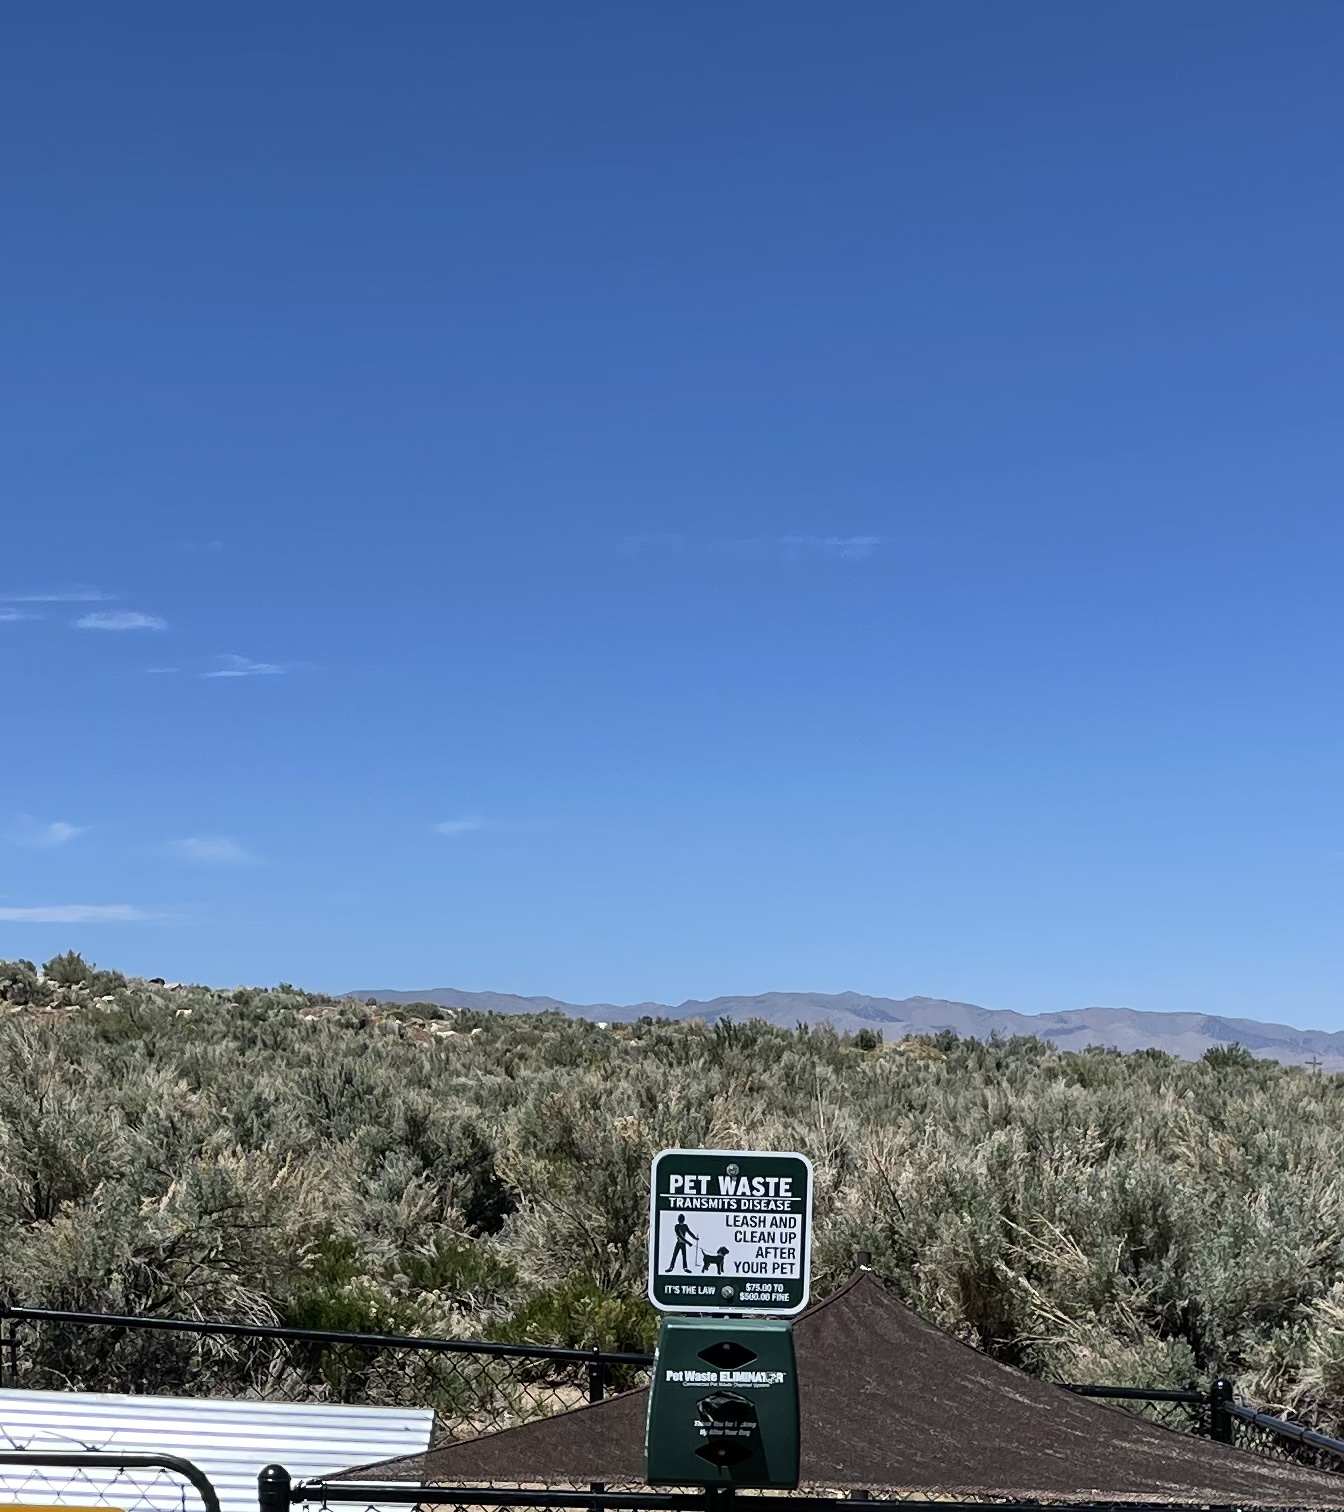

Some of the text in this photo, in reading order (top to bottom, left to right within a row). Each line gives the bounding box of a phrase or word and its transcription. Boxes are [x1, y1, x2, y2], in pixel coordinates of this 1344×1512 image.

[669, 1174, 793, 1197] PET WASTE
[669, 1197, 791, 1211] TRANSMITS DISEASE
[726, 1215, 797, 1229] LEASH AND
[734, 1230, 796, 1245] CLEAN UP
[755, 1246, 796, 1260] AFTER
[733, 1261, 795, 1275] YOUR PET
[664, 1285, 716, 1295] IT'S THE LAW
[745, 1283, 784, 1292] $75.00 TO
[772, 1293, 790, 1302] FINE
[666, 1370, 684, 1382] Pet
[684, 1370, 718, 1382] Waste
